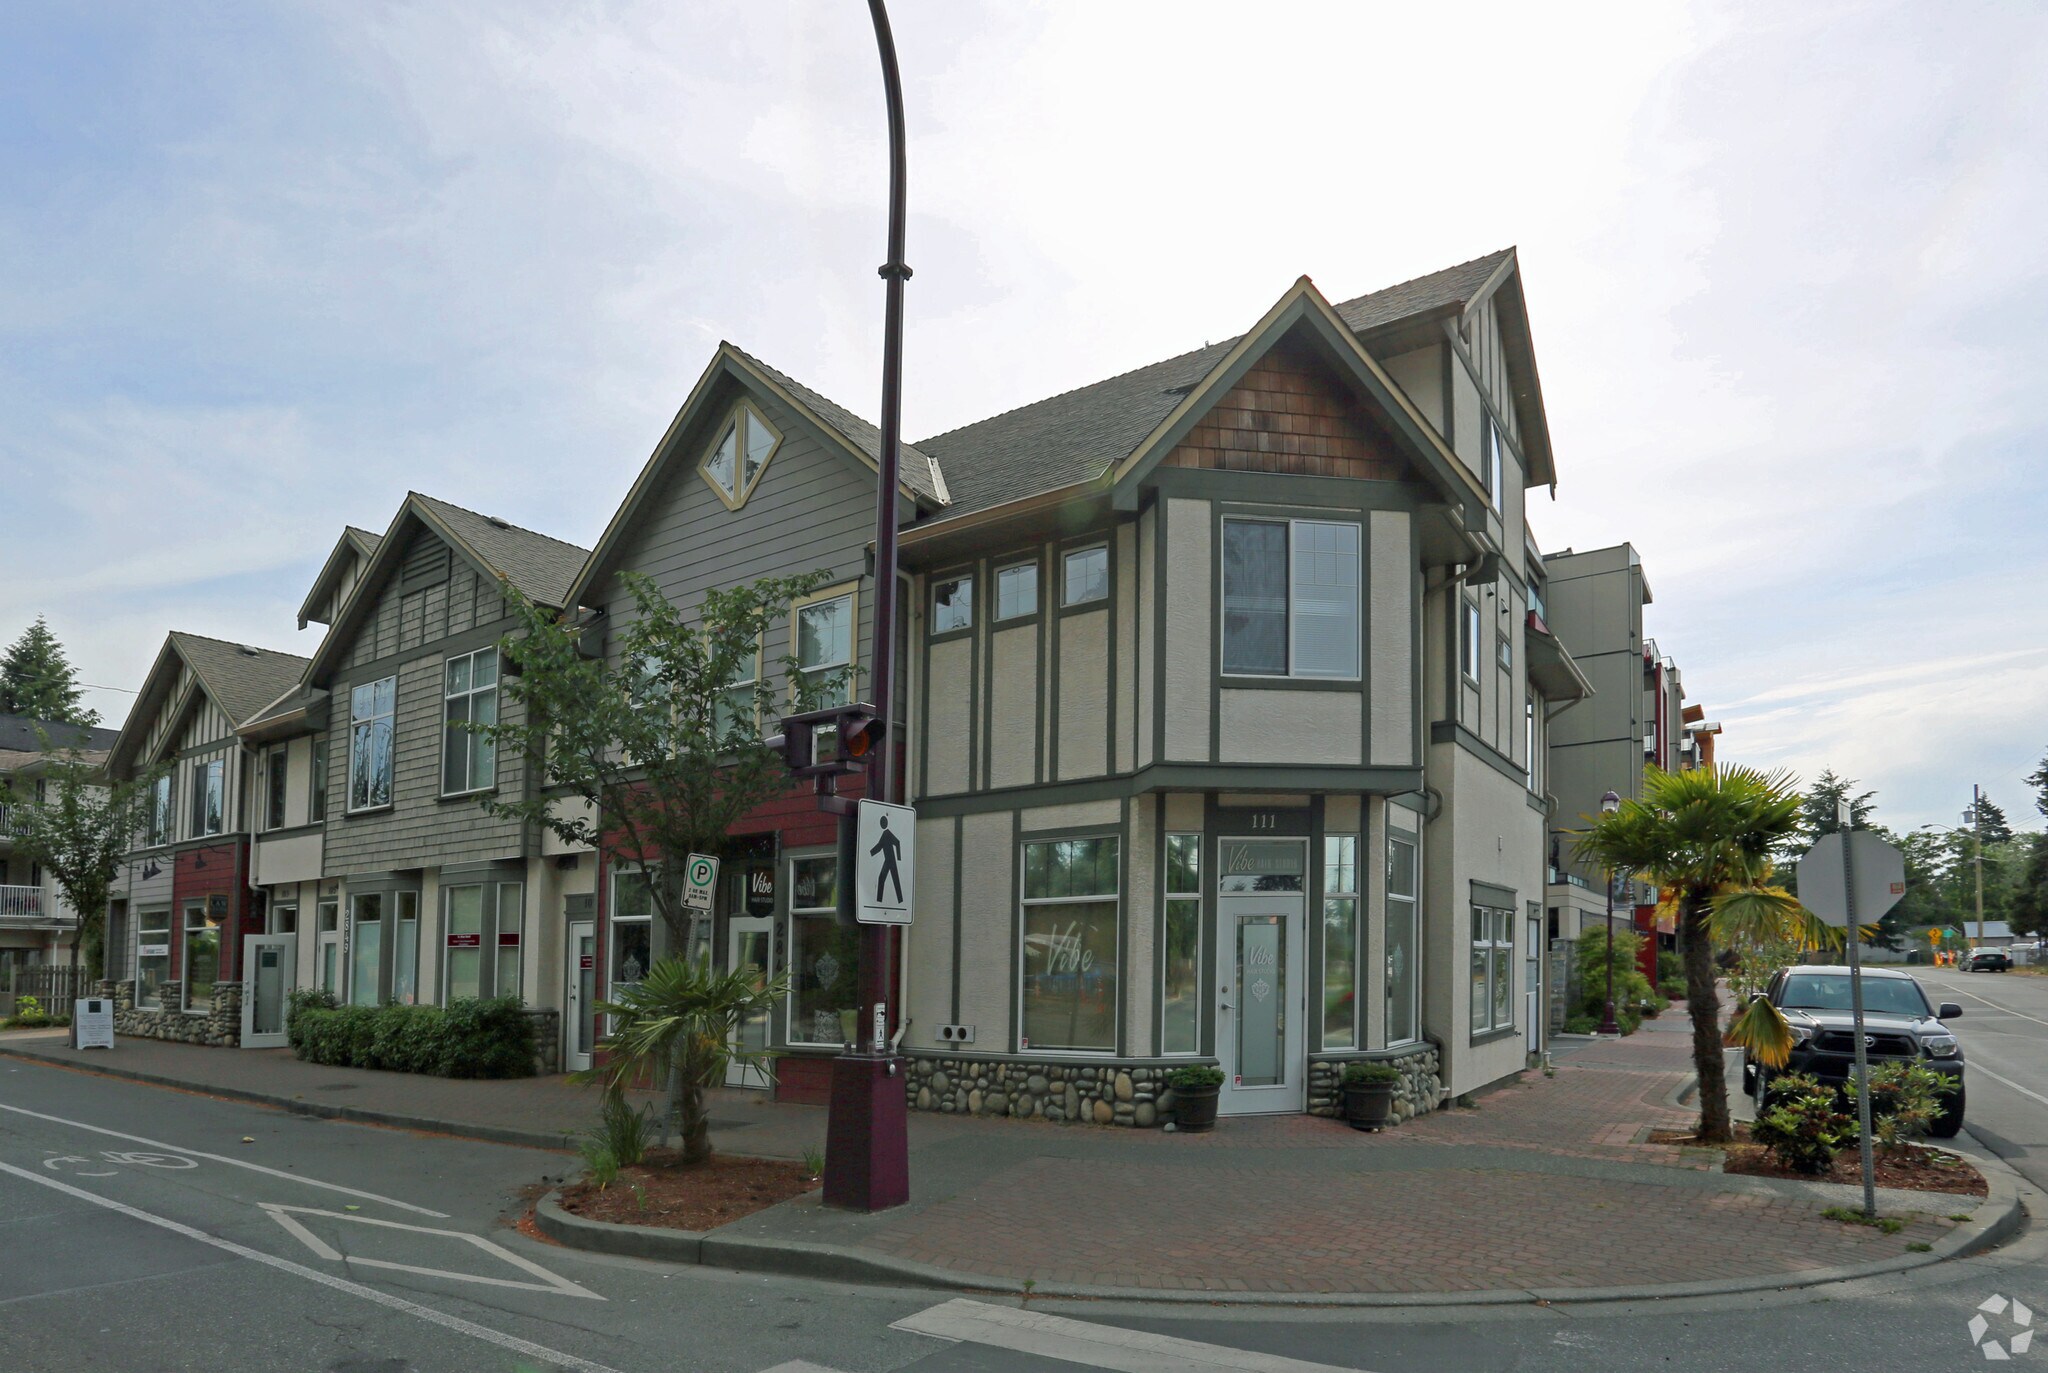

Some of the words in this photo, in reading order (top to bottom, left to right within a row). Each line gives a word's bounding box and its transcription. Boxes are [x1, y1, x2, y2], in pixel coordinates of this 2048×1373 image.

[1252, 814, 1275, 828] 111
[1228, 844, 1255, 874] Vibe
[697, 865, 708, 879] P
[752, 872, 773, 894] Vibe
[1046, 920, 1095, 976] Vibe
[1250, 945, 1274, 965] Vibe
